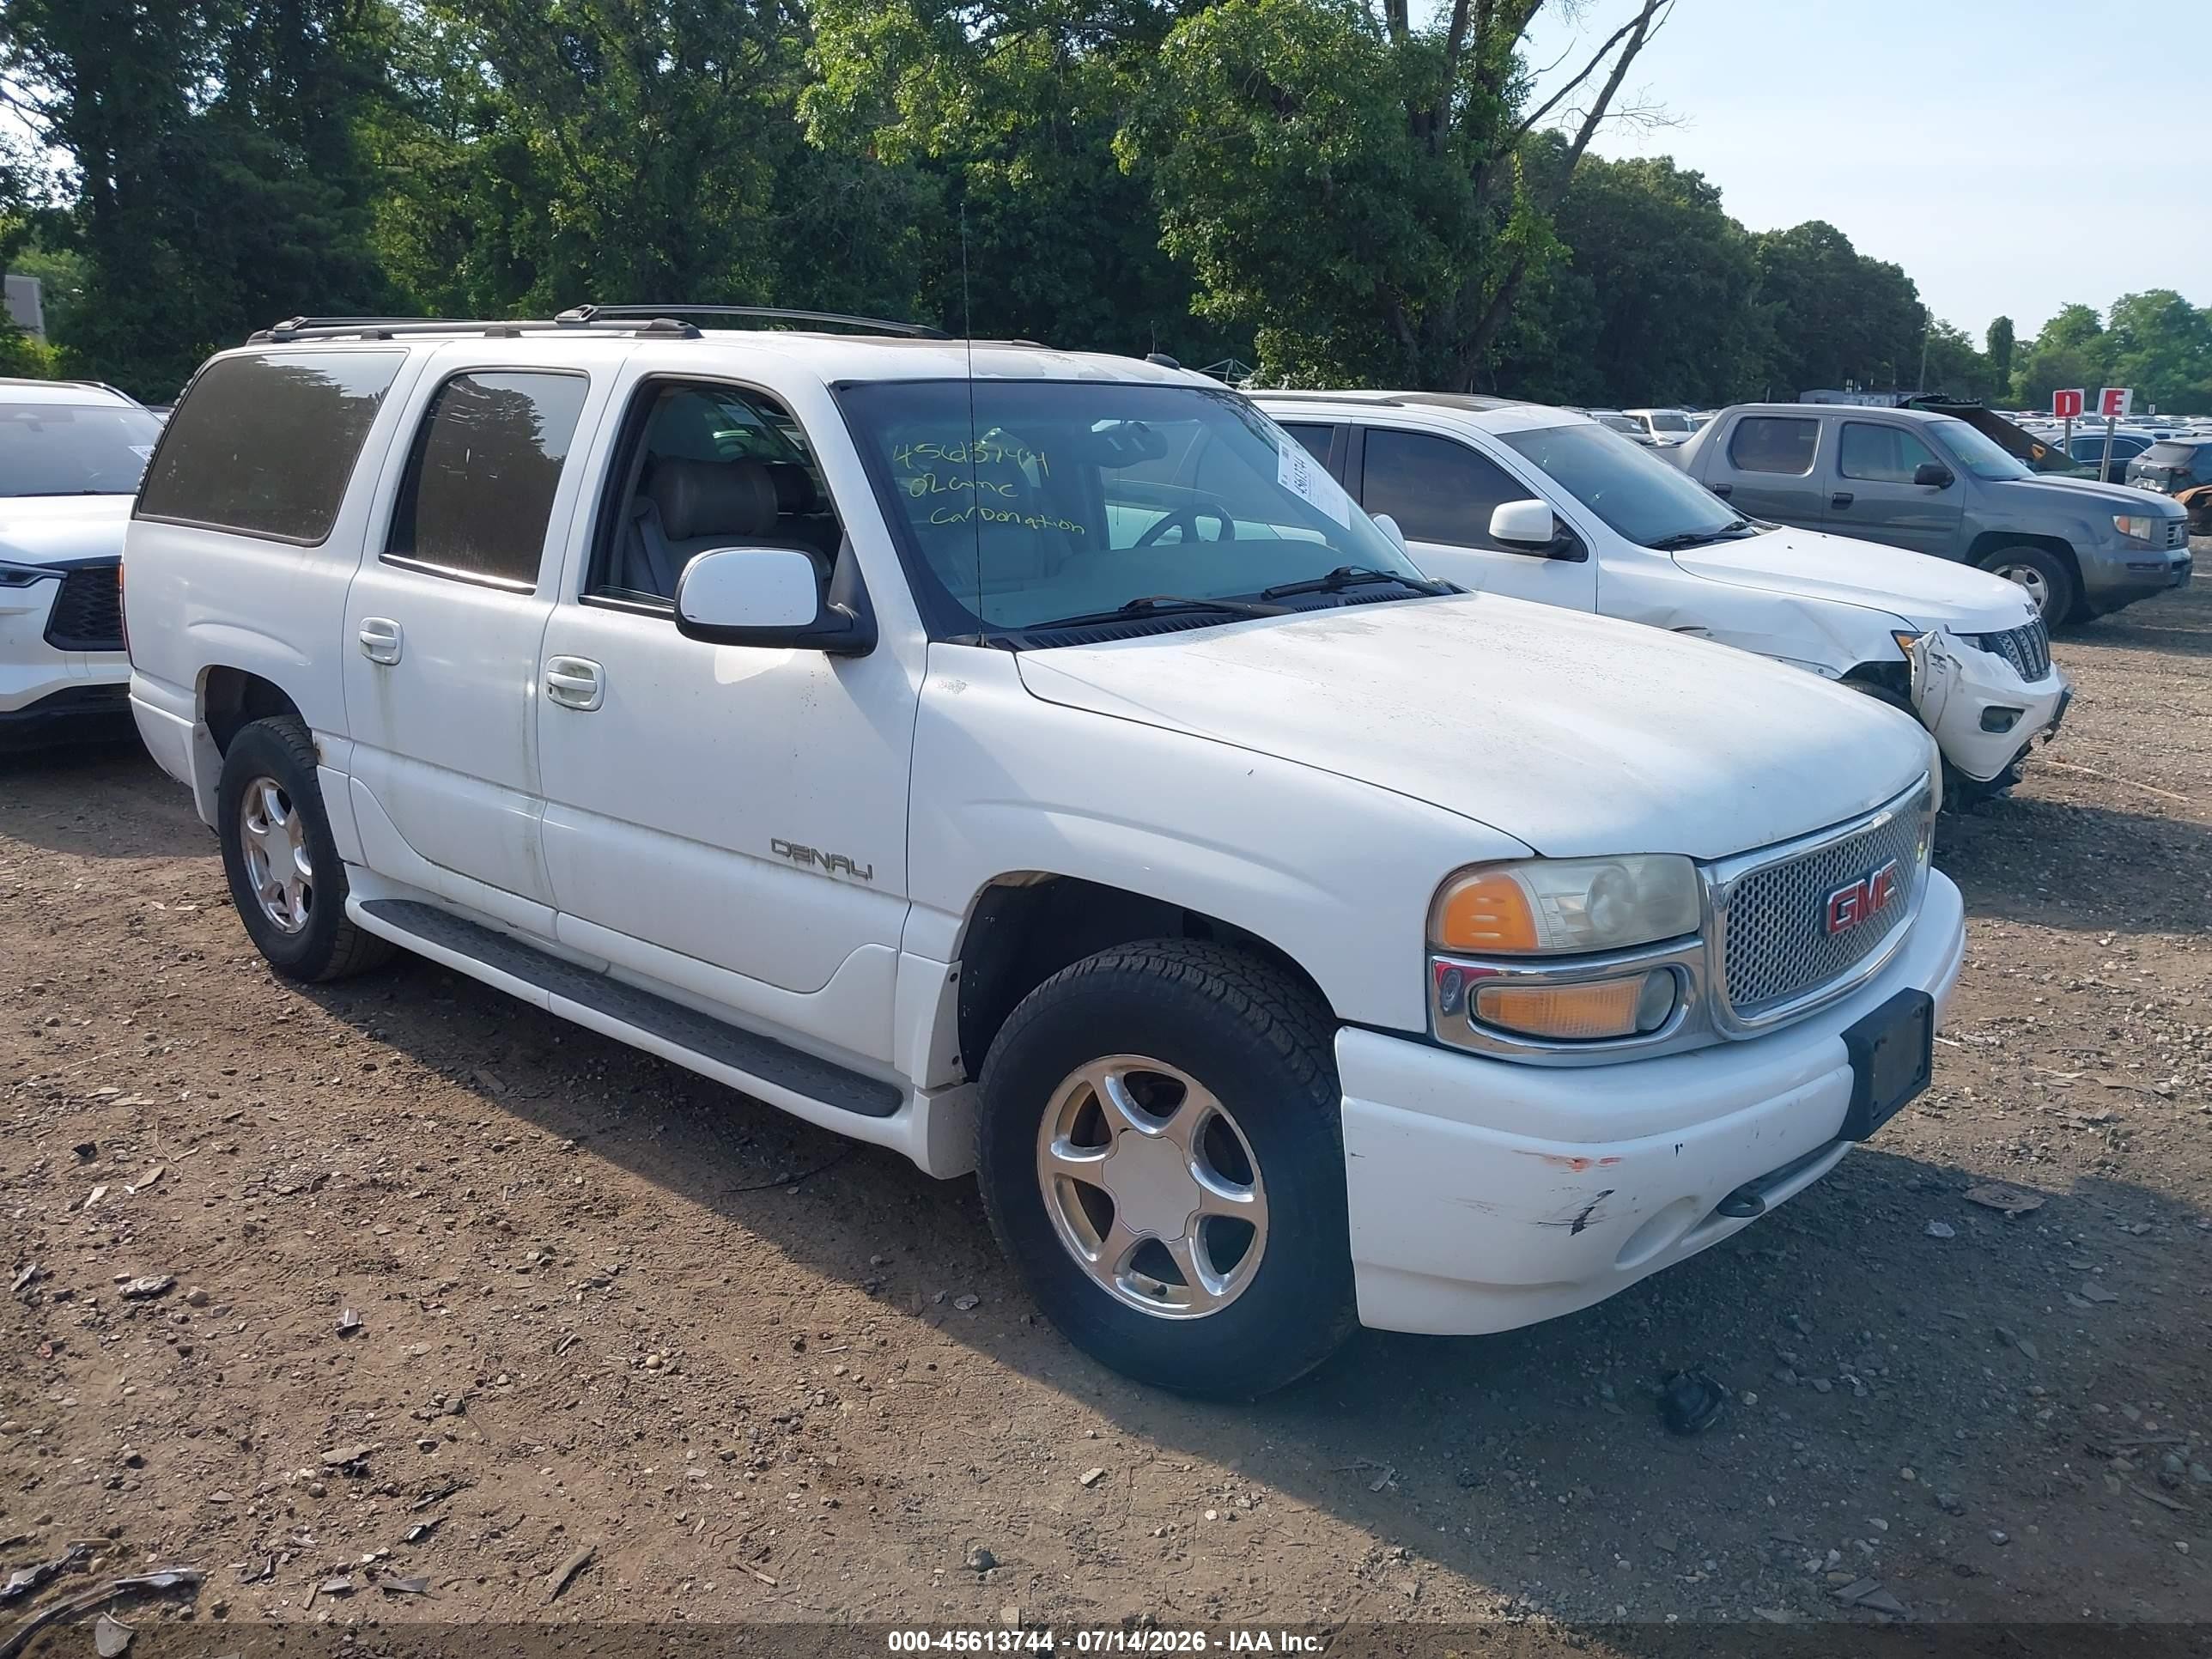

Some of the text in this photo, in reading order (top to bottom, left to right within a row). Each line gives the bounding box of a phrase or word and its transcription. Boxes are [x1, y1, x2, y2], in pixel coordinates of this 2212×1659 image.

[2055, 391, 2081, 417] D
[2102, 390, 2125, 416] E
[770, 837, 873, 880] DENALI
[1826, 858, 1898, 936] GMC
